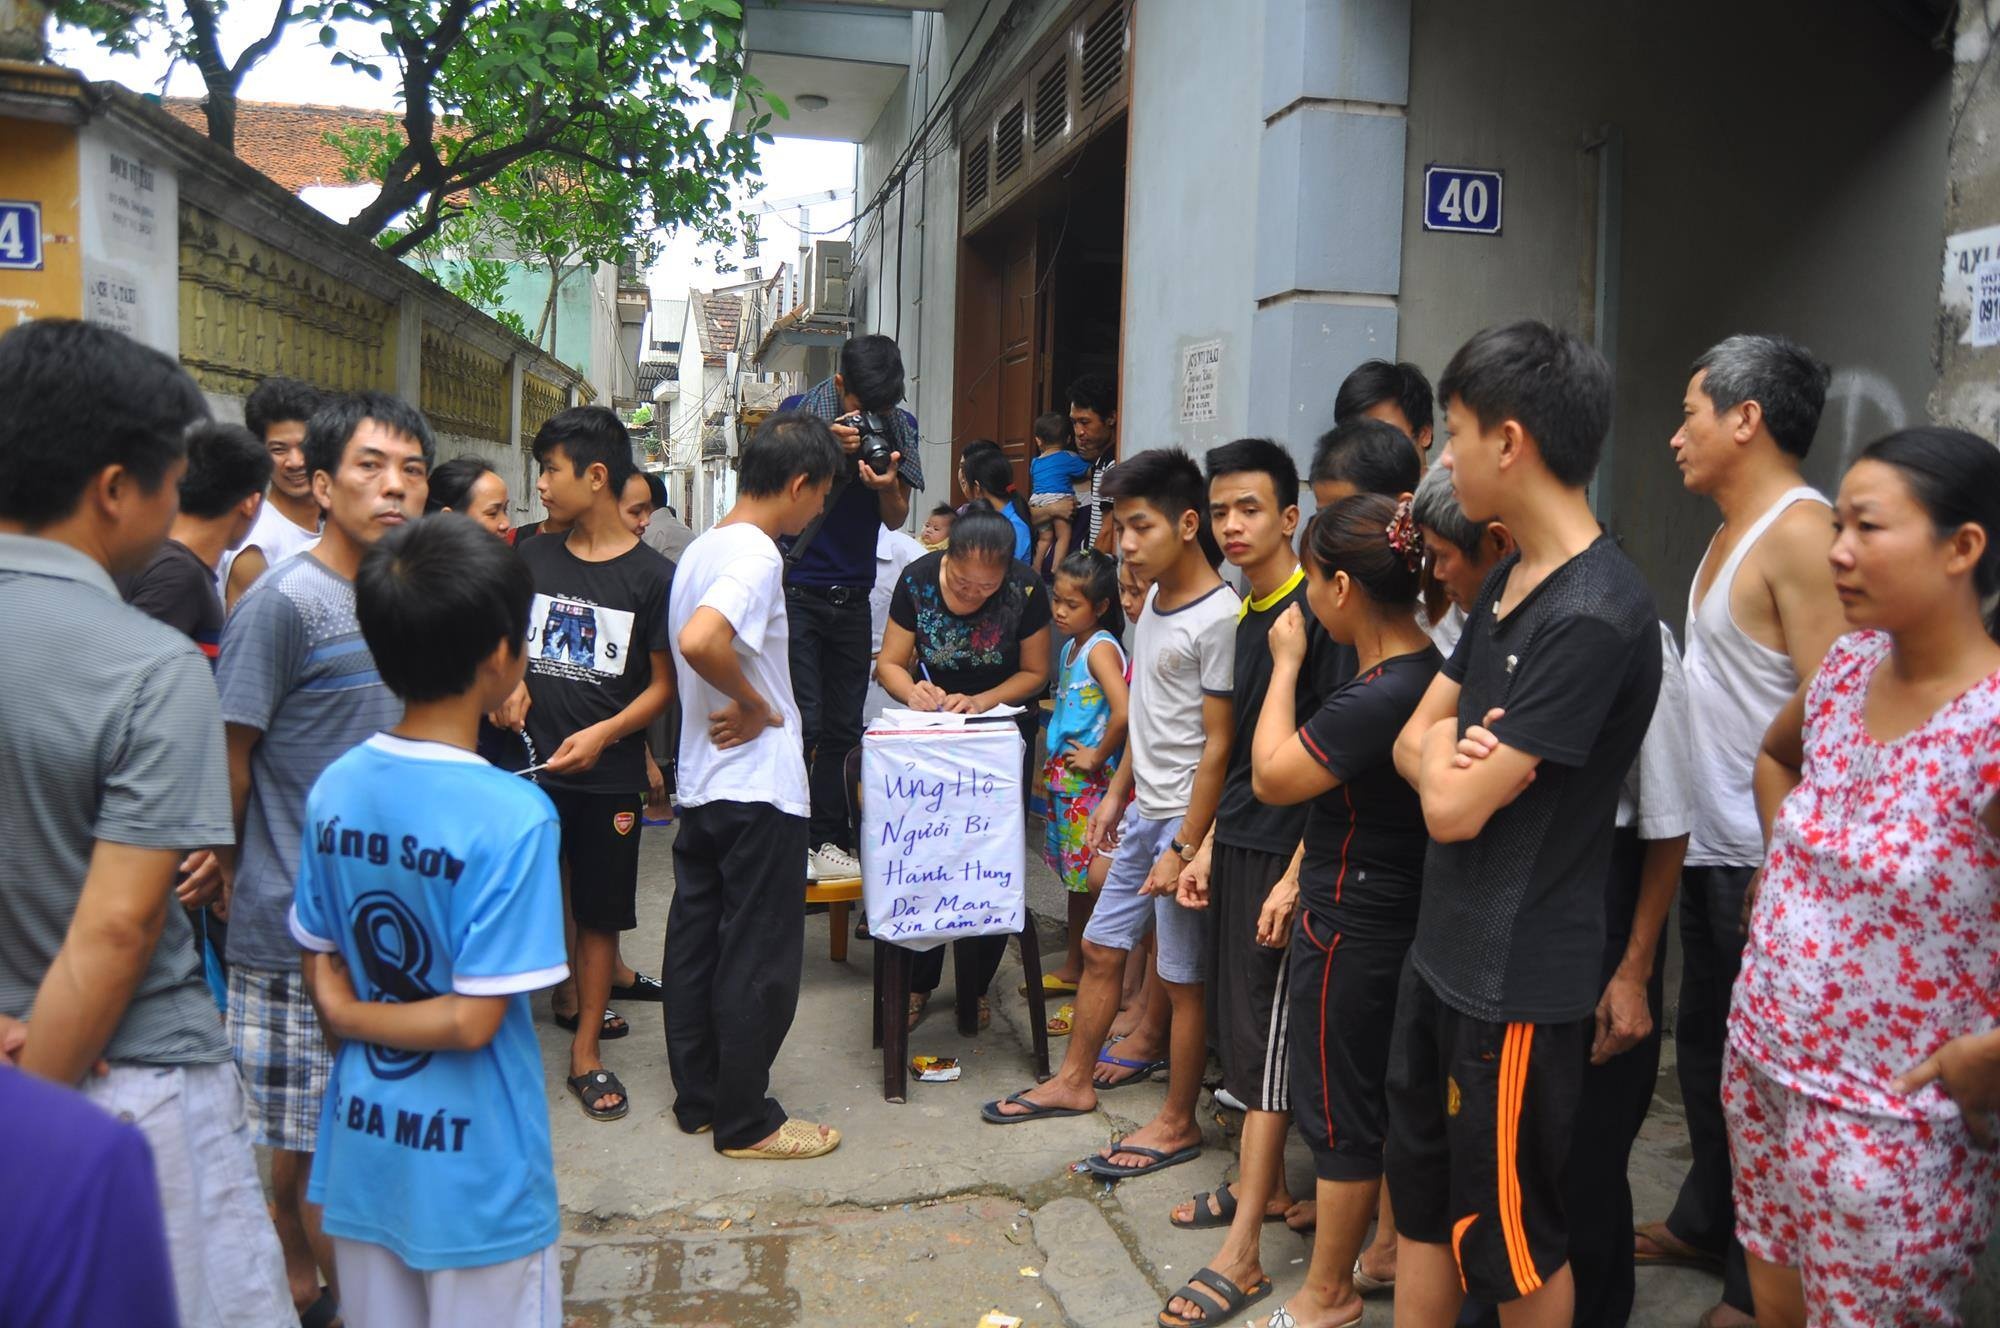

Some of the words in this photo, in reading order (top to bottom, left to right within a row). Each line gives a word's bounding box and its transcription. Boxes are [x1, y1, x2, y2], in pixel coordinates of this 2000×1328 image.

[1438, 178, 1488, 223] 40
[1954, 246, 1989, 274] AXI
[1979, 298, 2000, 322] 091
[605, 642, 618, 659] S
[949, 767, 996, 798] Hộ
[965, 815, 992, 837] Bị
[934, 894, 1000, 914] Man
[347, 1095, 386, 1139] BA
[395, 1108, 471, 1152] MÁT
